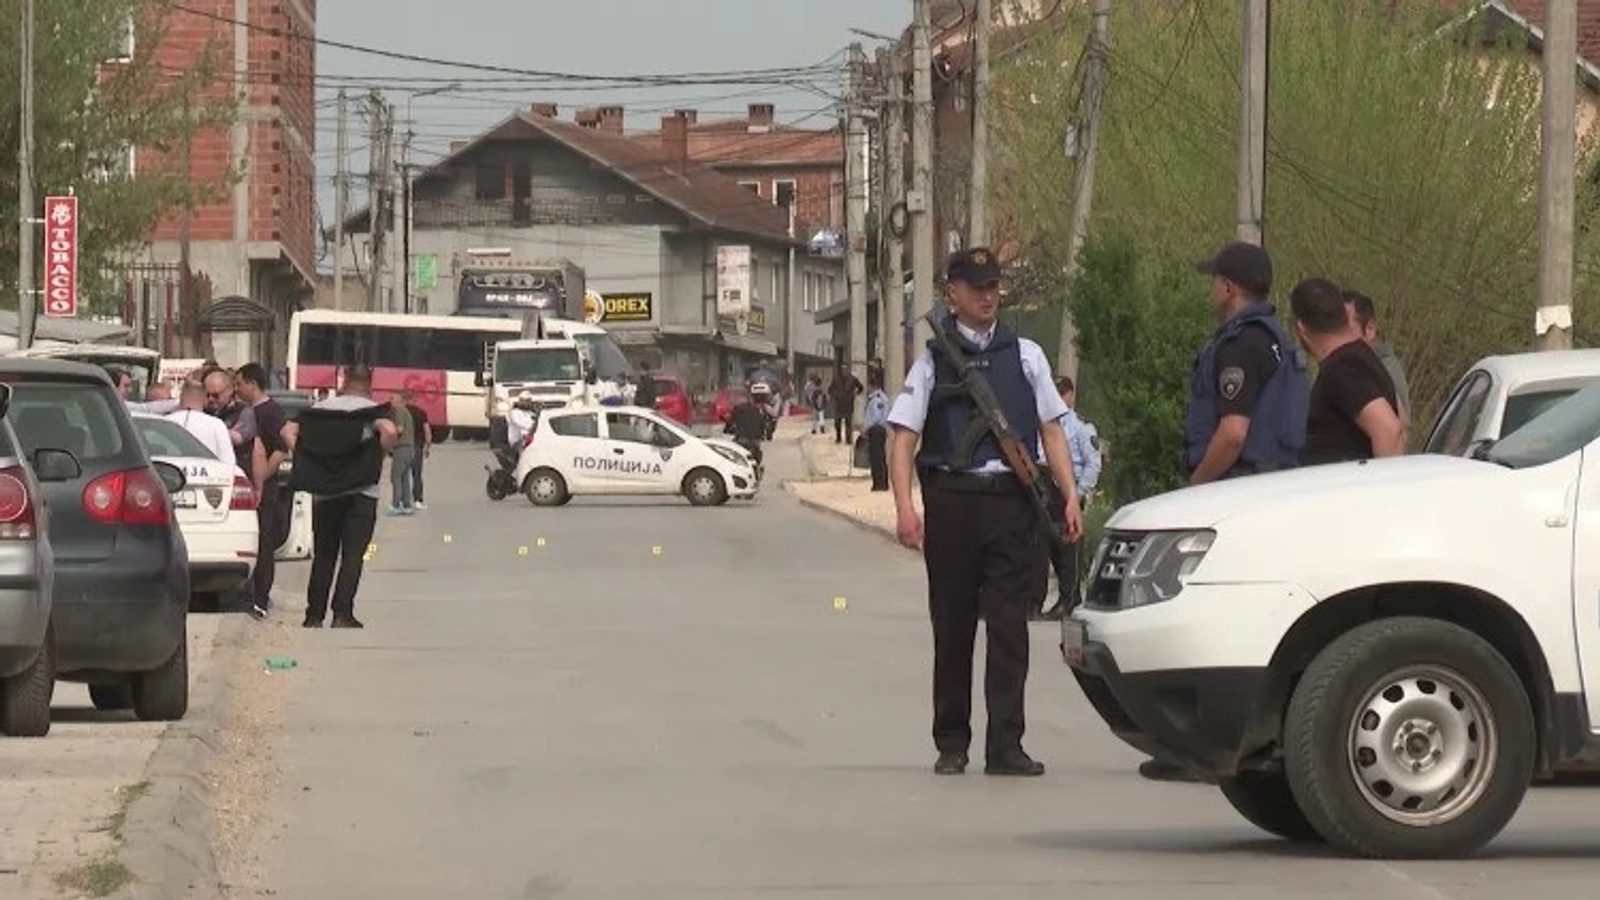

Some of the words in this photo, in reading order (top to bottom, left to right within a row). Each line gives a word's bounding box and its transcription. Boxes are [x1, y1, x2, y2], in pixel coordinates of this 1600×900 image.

[51, 228, 71, 311] TOBACCO
[605, 298, 649, 313] OREX
[573, 456, 663, 475] ПОЛИЦИЈА
